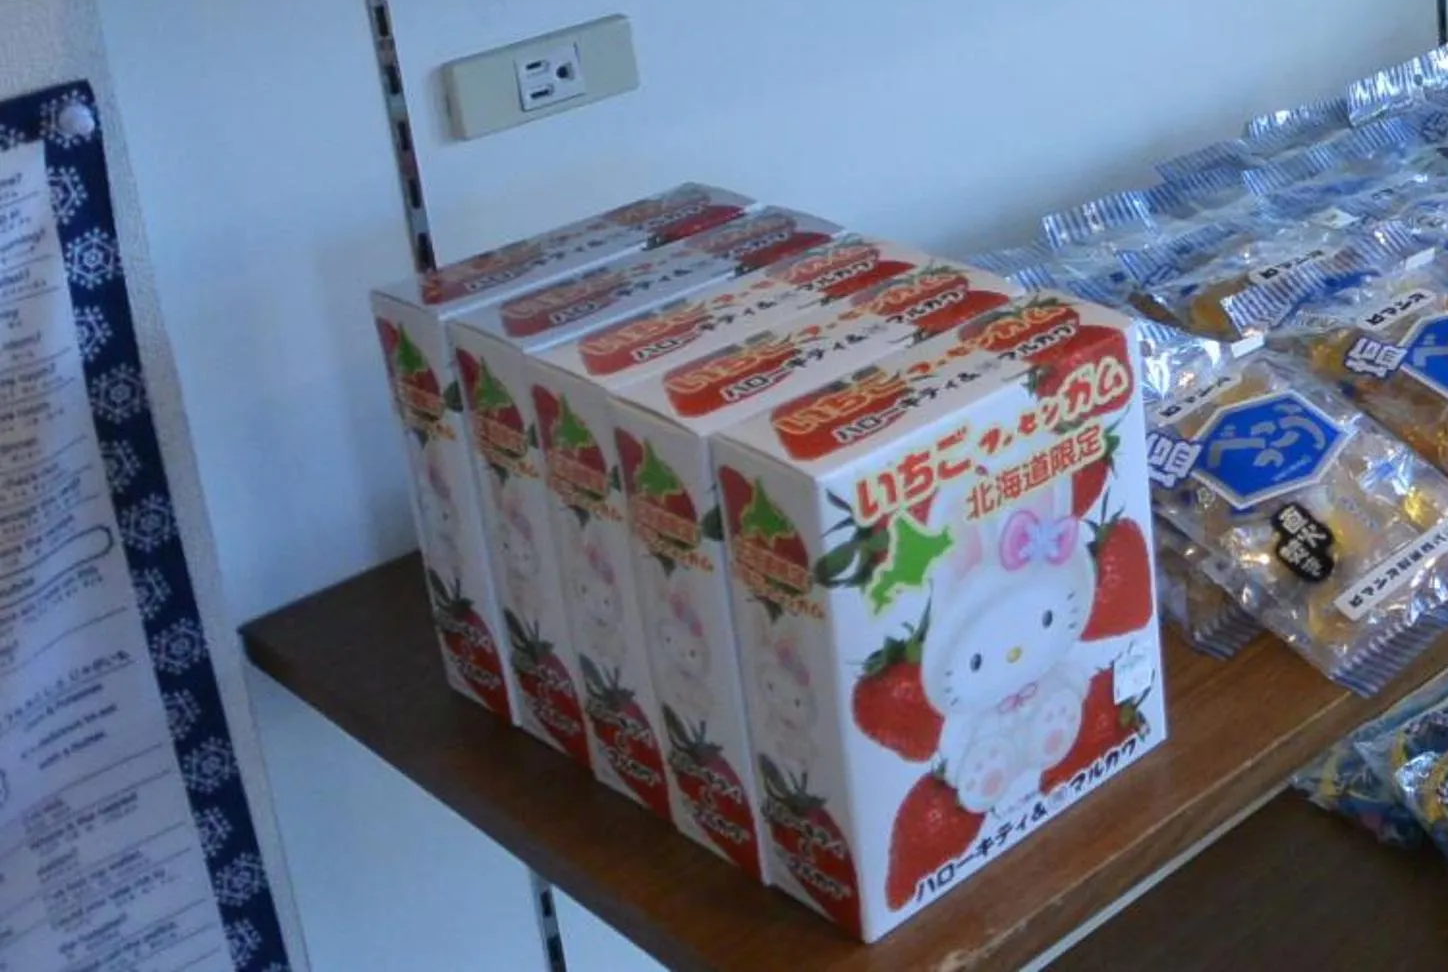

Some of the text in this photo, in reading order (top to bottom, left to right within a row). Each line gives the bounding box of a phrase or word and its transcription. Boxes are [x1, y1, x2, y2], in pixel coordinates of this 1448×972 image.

[1344, 336, 1408, 379] 塩
[1206, 402, 1327, 471] べっこう
[964, 430, 1105, 518] 北海道限定
[1069, 738, 1137, 792] マルカワ
